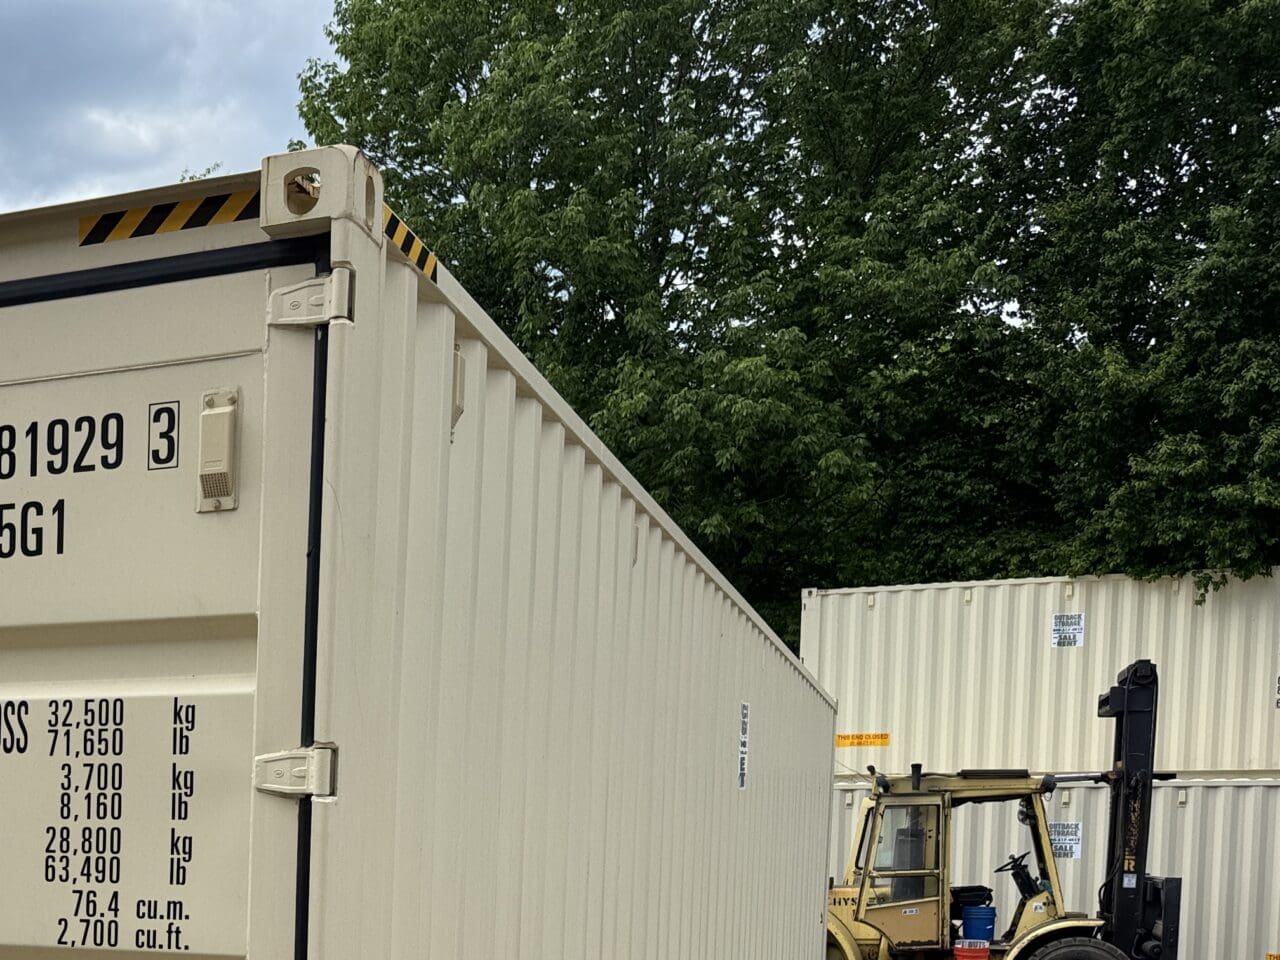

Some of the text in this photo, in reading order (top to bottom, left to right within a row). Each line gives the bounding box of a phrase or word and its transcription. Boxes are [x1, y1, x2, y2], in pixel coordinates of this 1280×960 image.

[151, 407, 176, 465] 3
[48, 698, 124, 729] 32,500
[173, 697, 196, 731] kg
[47, 727, 190, 758] 71,650 lb
[60, 763, 123, 793] 3,700
[171, 762, 195, 797] kg
[60, 792, 188, 821] 8,160 lb
[45, 826, 121, 856] 28,800
[170, 827, 193, 862] kg
[44, 855, 187, 886] 63,490 lb
[71, 890, 120, 918] 76.4
[136, 899, 190, 920] cu.m.
[57, 918, 190, 951] 2,700 cu.ft.
